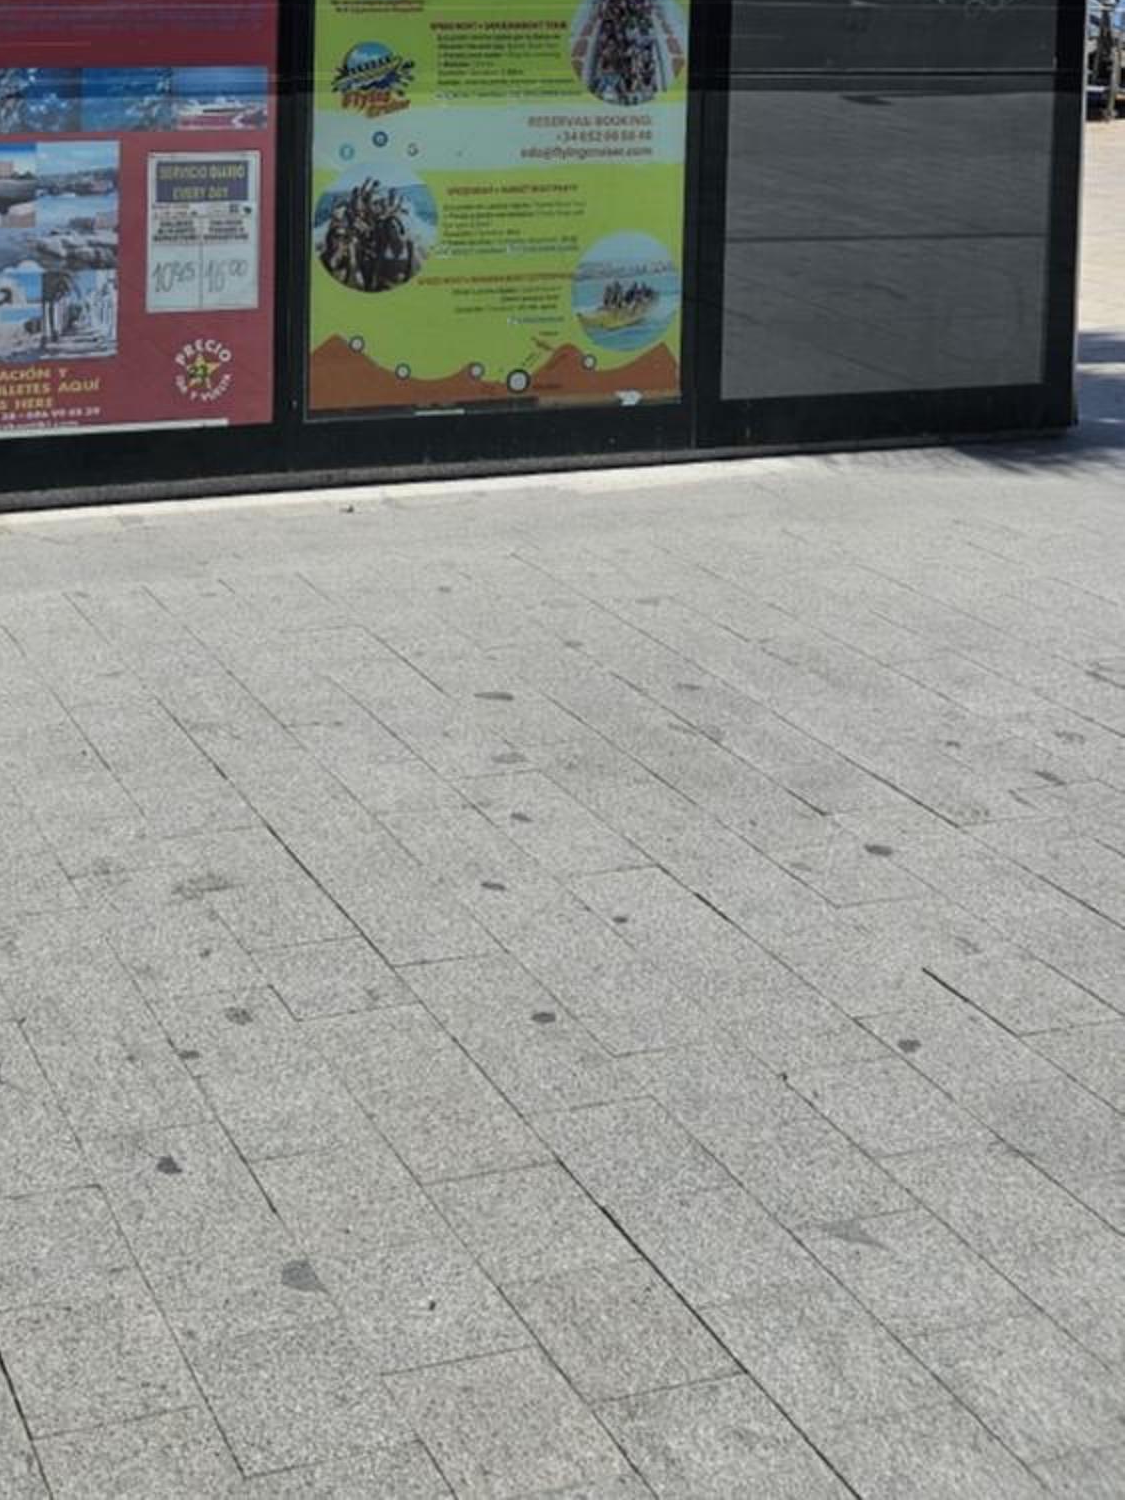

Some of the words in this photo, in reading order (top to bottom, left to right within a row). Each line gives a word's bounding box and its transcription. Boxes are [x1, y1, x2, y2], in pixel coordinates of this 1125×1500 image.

[174, 339, 232, 366] PRECIO
[58, 368, 68, 379] Y
[58, 378, 101, 393] AQUÍ
[14, 397, 53, 411] HERE
